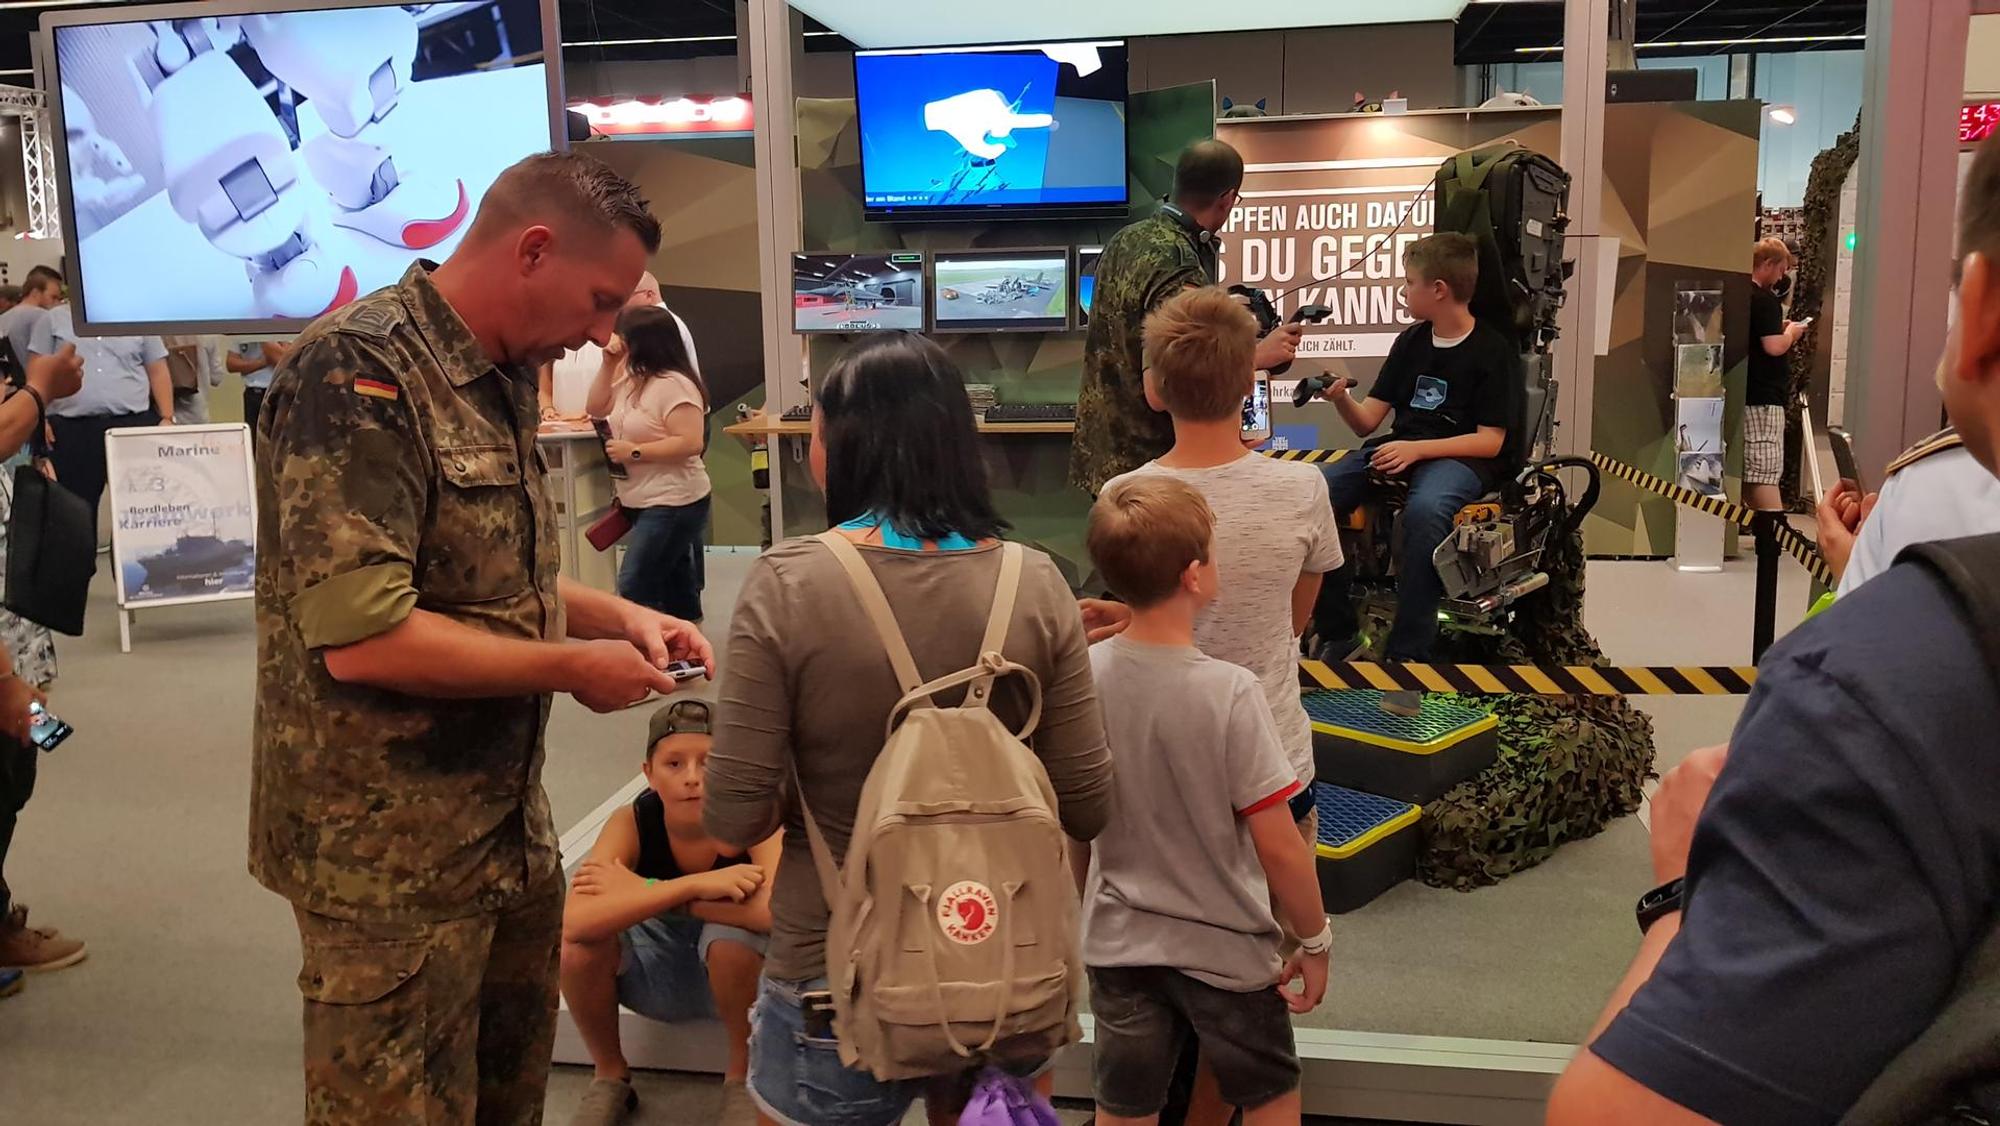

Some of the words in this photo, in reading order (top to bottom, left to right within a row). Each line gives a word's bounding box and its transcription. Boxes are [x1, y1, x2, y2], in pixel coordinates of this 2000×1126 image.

[1221, 206, 1287, 233] PFEN
[1295, 203, 1357, 231] AUCH
[1242, 237, 1295, 283] DU
[1311, 232, 1434, 281] GEGE
[1322, 338, 1356, 353] ZÄHLT.
[158, 444, 221, 458] Marine
[118, 516, 183, 530] Karriere
